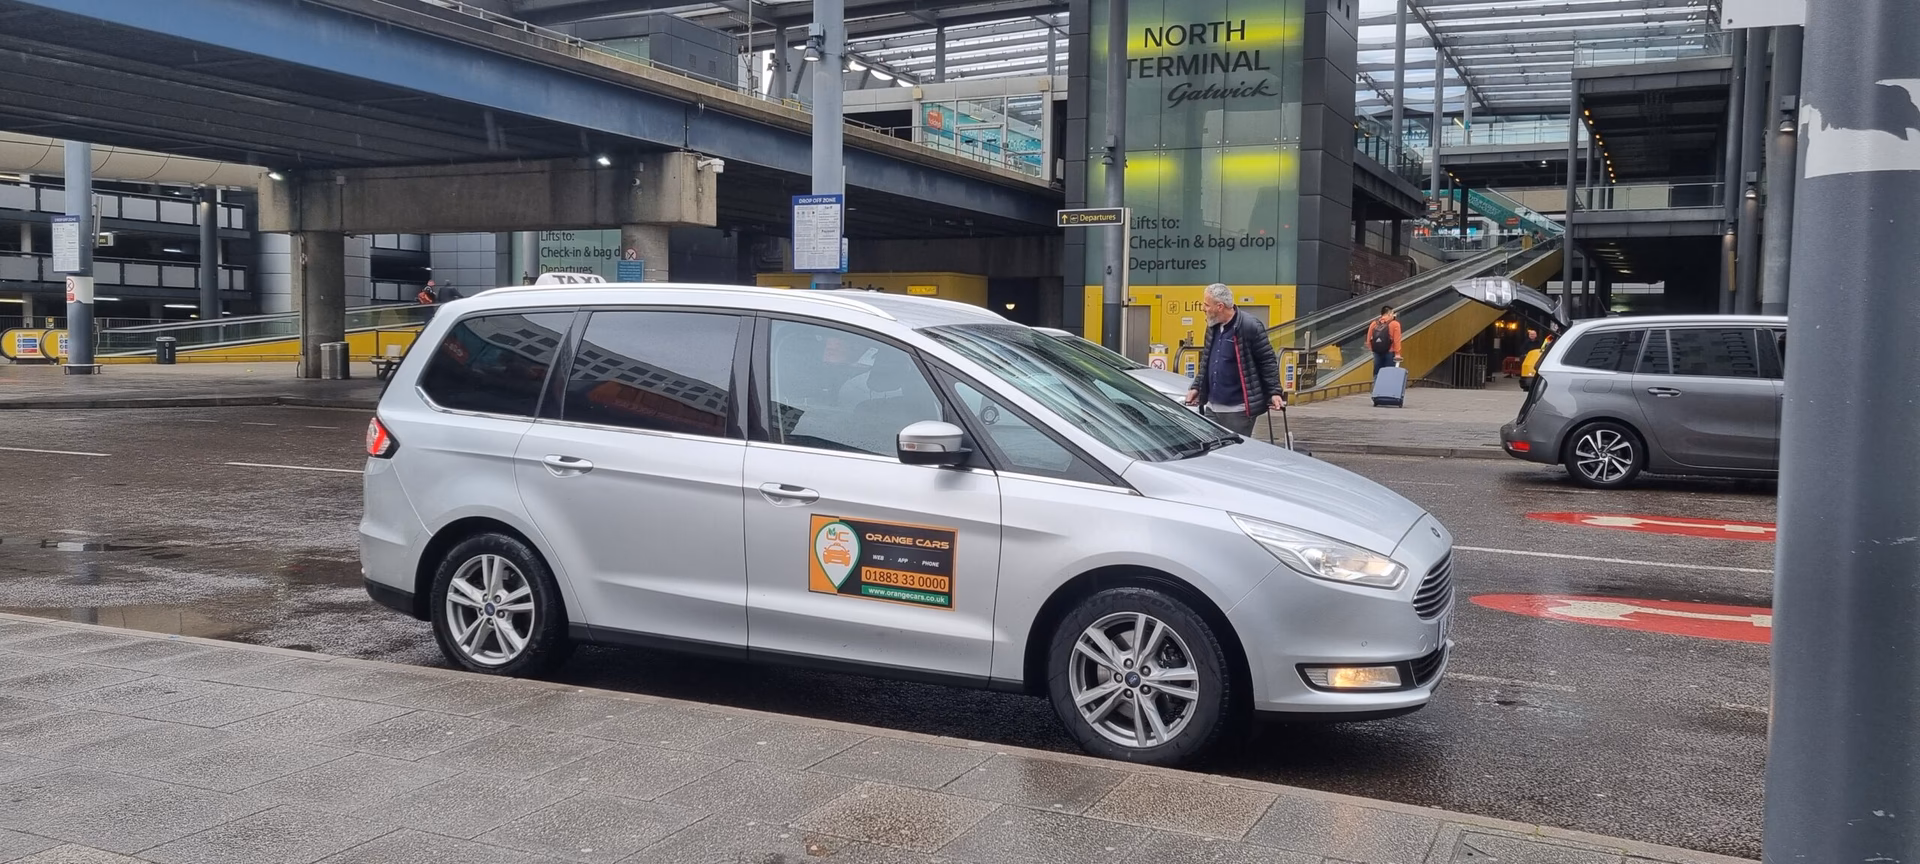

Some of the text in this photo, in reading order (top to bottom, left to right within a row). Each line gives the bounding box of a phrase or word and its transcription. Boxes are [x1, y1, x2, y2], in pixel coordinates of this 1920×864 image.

[1144, 19, 1246, 48] NORTH
[1126, 50, 1270, 79] TERMINAL
[1167, 78, 1278, 109] Gatwick
[1080, 213, 1116, 223] Departures
[1130, 216, 1180, 229] Lifts to:
[540, 230, 575, 241] Lifts to:
[1129, 233, 1276, 251] Check-in & bag drop
[540, 246, 581, 258] Check-in
[583, 247, 591, 257] &
[593, 246, 612, 260] bag
[540, 264, 593, 274] Departures
[1128, 257, 1207, 273] Departures
[552, 275, 600, 284] TAXI
[1184, 300, 1204, 312] Lift
[865, 532, 950, 550] ORANGE CARS
[921, 560, 940, 568] PHONE
[865, 569, 946, 590] 01883 33 0000
[868, 587, 945, 603] www.orangecars.co.uk
